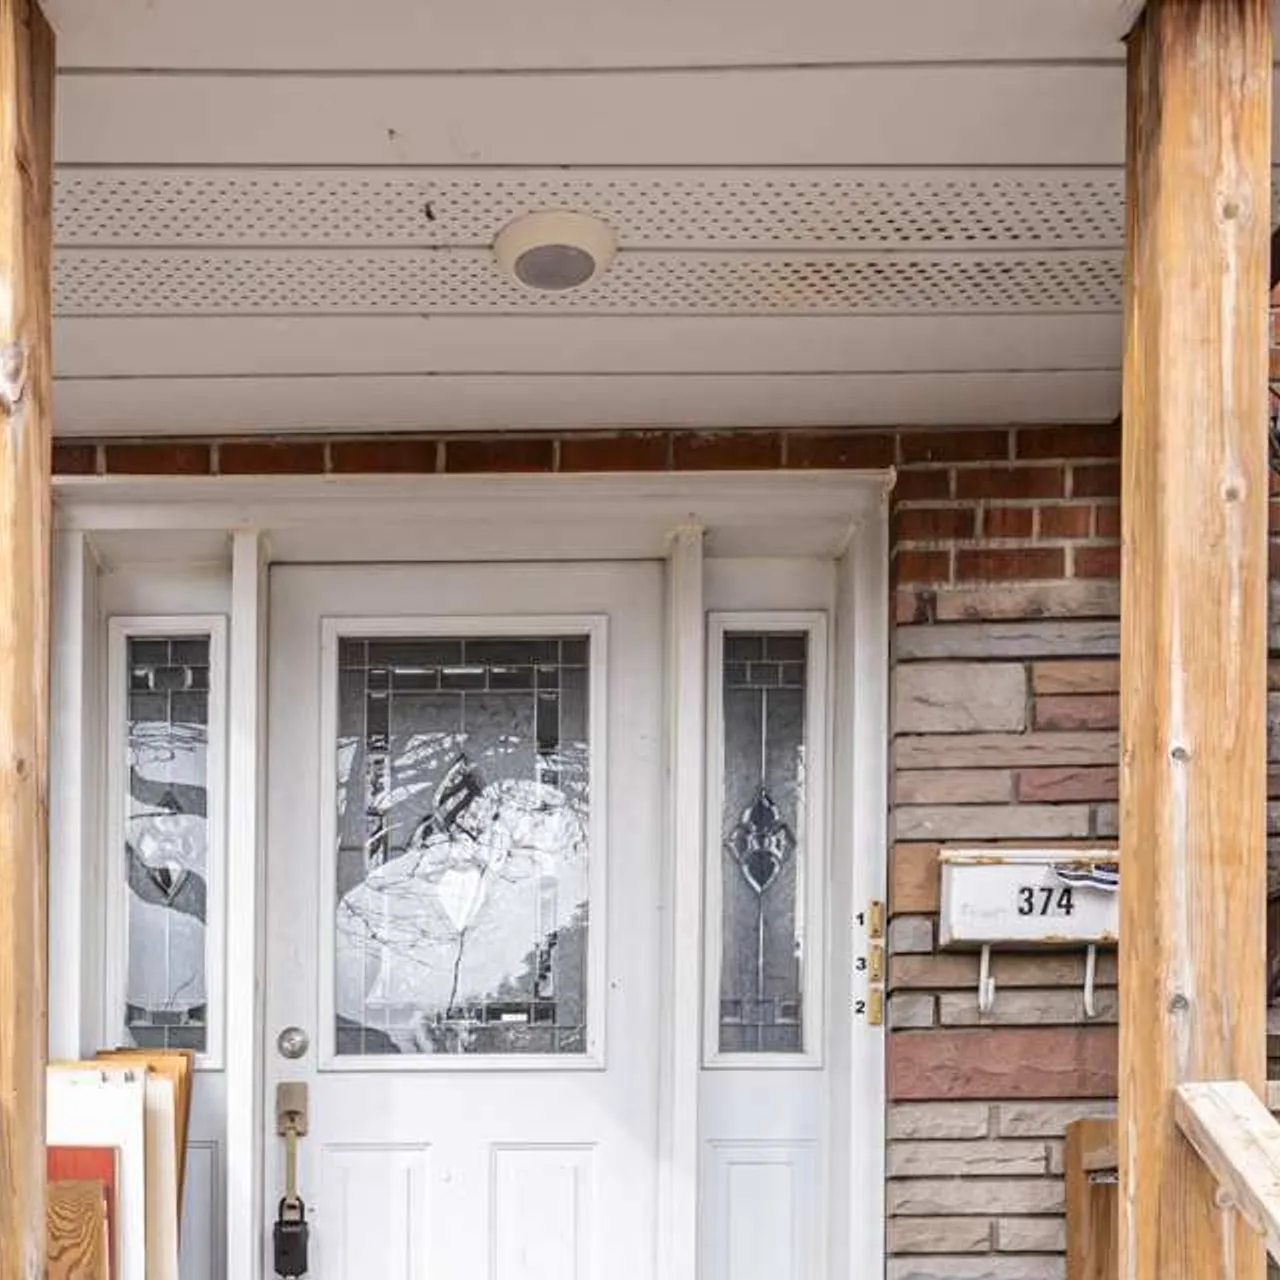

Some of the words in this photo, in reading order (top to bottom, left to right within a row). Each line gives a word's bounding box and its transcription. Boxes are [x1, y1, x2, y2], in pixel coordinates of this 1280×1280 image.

[1017, 887, 1075, 916] 374
[856, 912, 865, 926] 1
[856, 957, 867, 971] 3
[855, 1000, 866, 1014] 2
